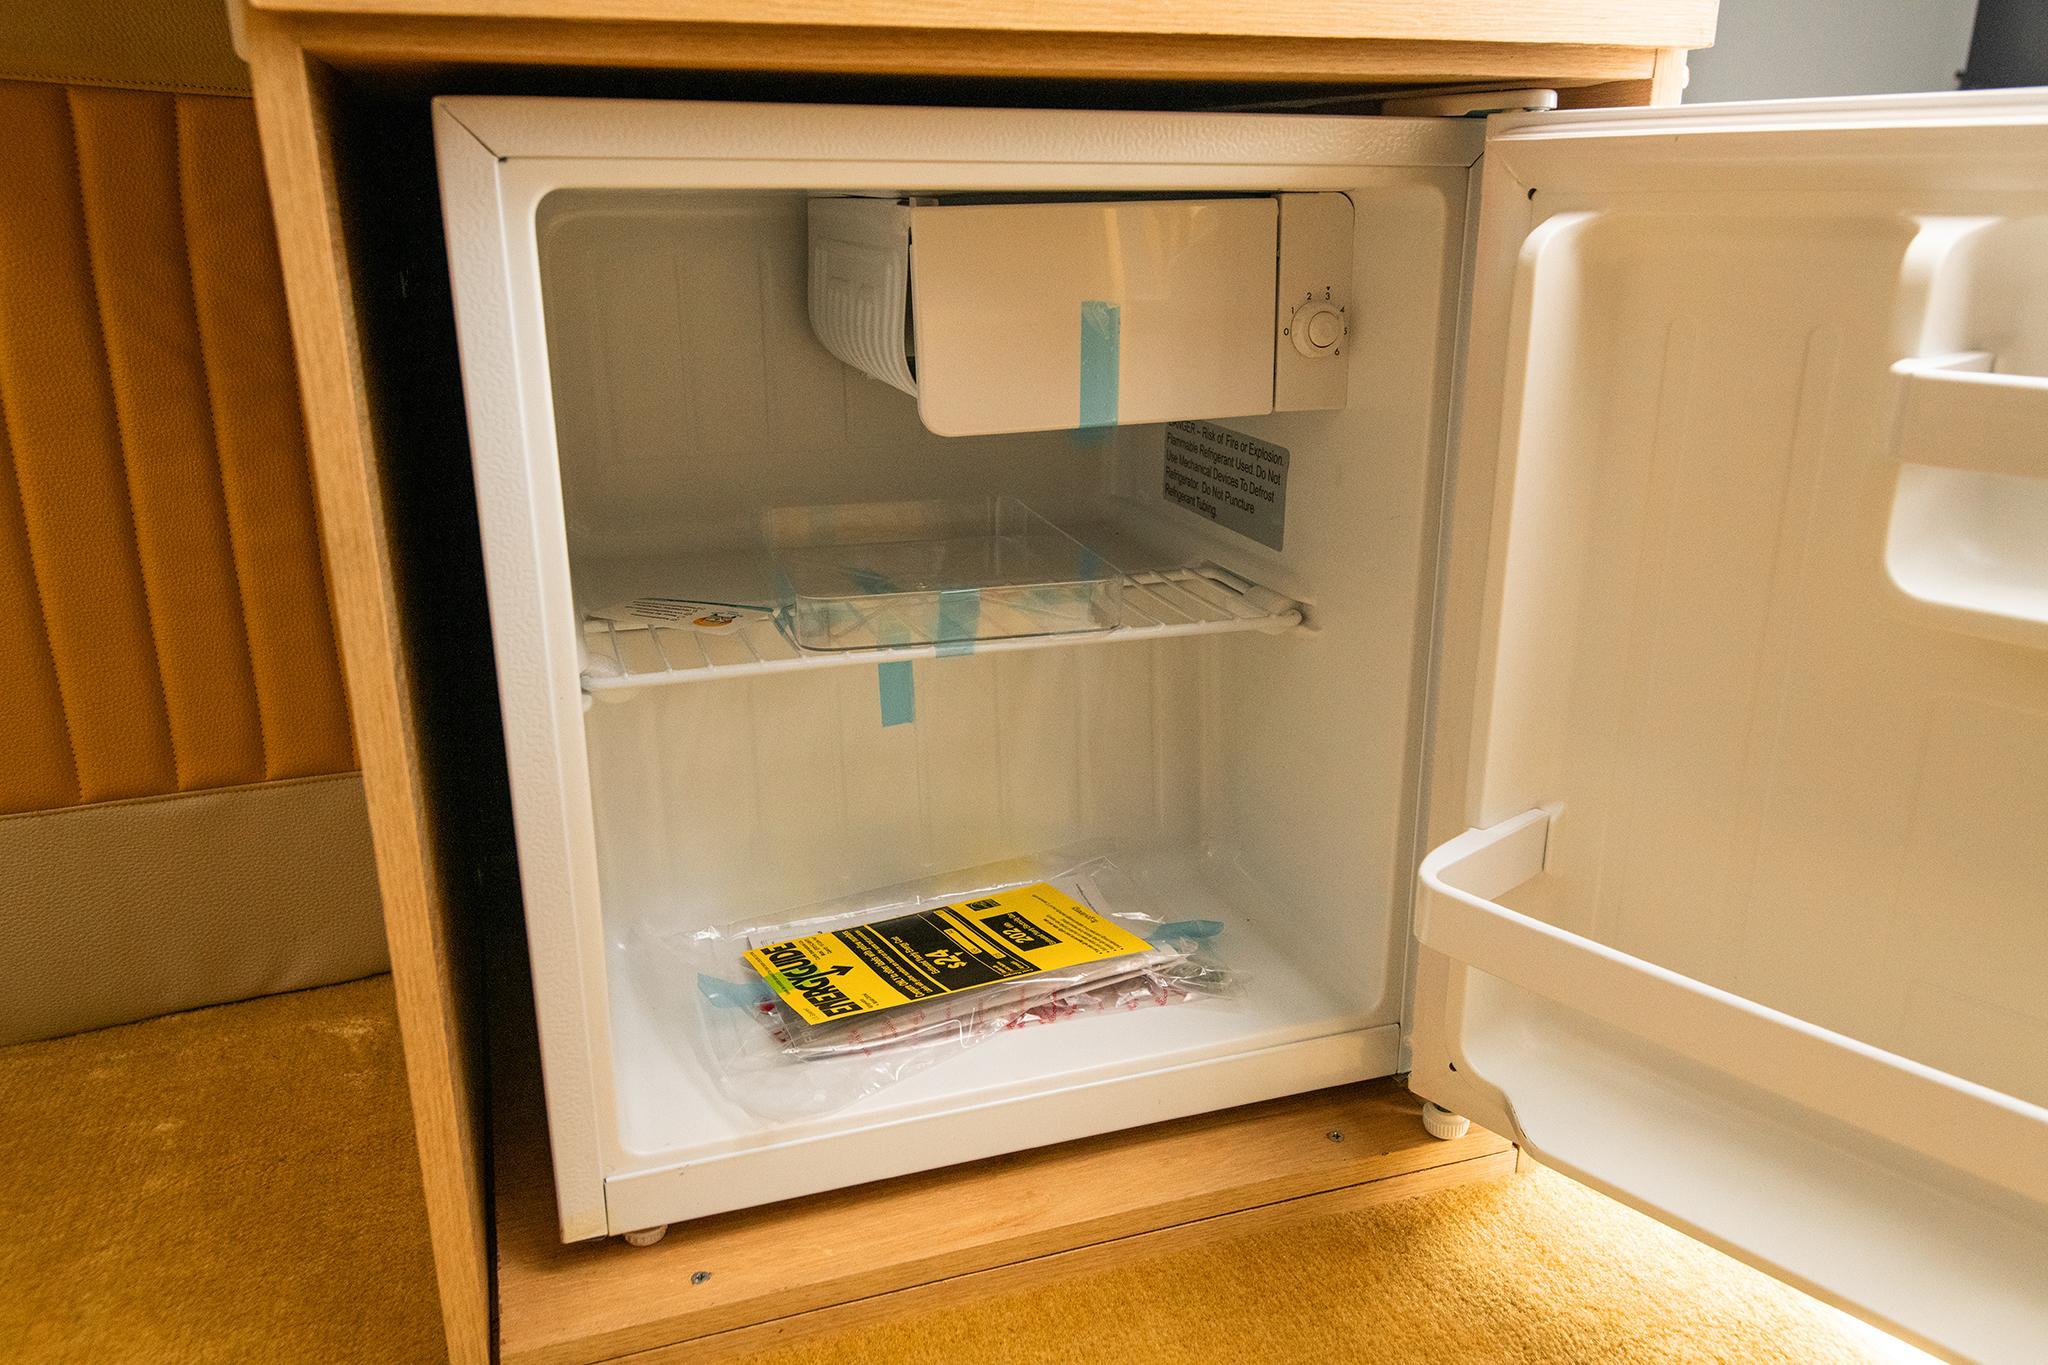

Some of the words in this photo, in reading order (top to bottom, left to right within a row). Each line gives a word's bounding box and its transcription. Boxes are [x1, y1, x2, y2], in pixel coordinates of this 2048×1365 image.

[1306, 292, 1312, 301] 2
[1325, 292, 1331, 301] 3
[1283, 327, 1289, 336] 0
[1334, 348, 1340, 356] 6
[1202, 427, 1215, 441] Risk
[1217, 433, 1224, 443] of
[1226, 434, 1239, 450] Fire
[1240, 442, 1248, 452] or
[1199, 444, 1234, 467] Refrigerant
[1256, 465, 1266, 479] Do
[1267, 472, 1281, 485] Not
[1213, 469, 1239, 488] Devices
[1240, 478, 1248, 491] To
[1249, 483, 1275, 503] Defrost
[1202, 482, 1211, 495] Do
[1212, 487, 1224, 500] Not
[1225, 491, 1255, 514] Puncture
[1003, 928, 1035, 943] 202
[925, 949, 967, 968] $24
[760, 941, 863, 1018] ENERGYGUIDE
